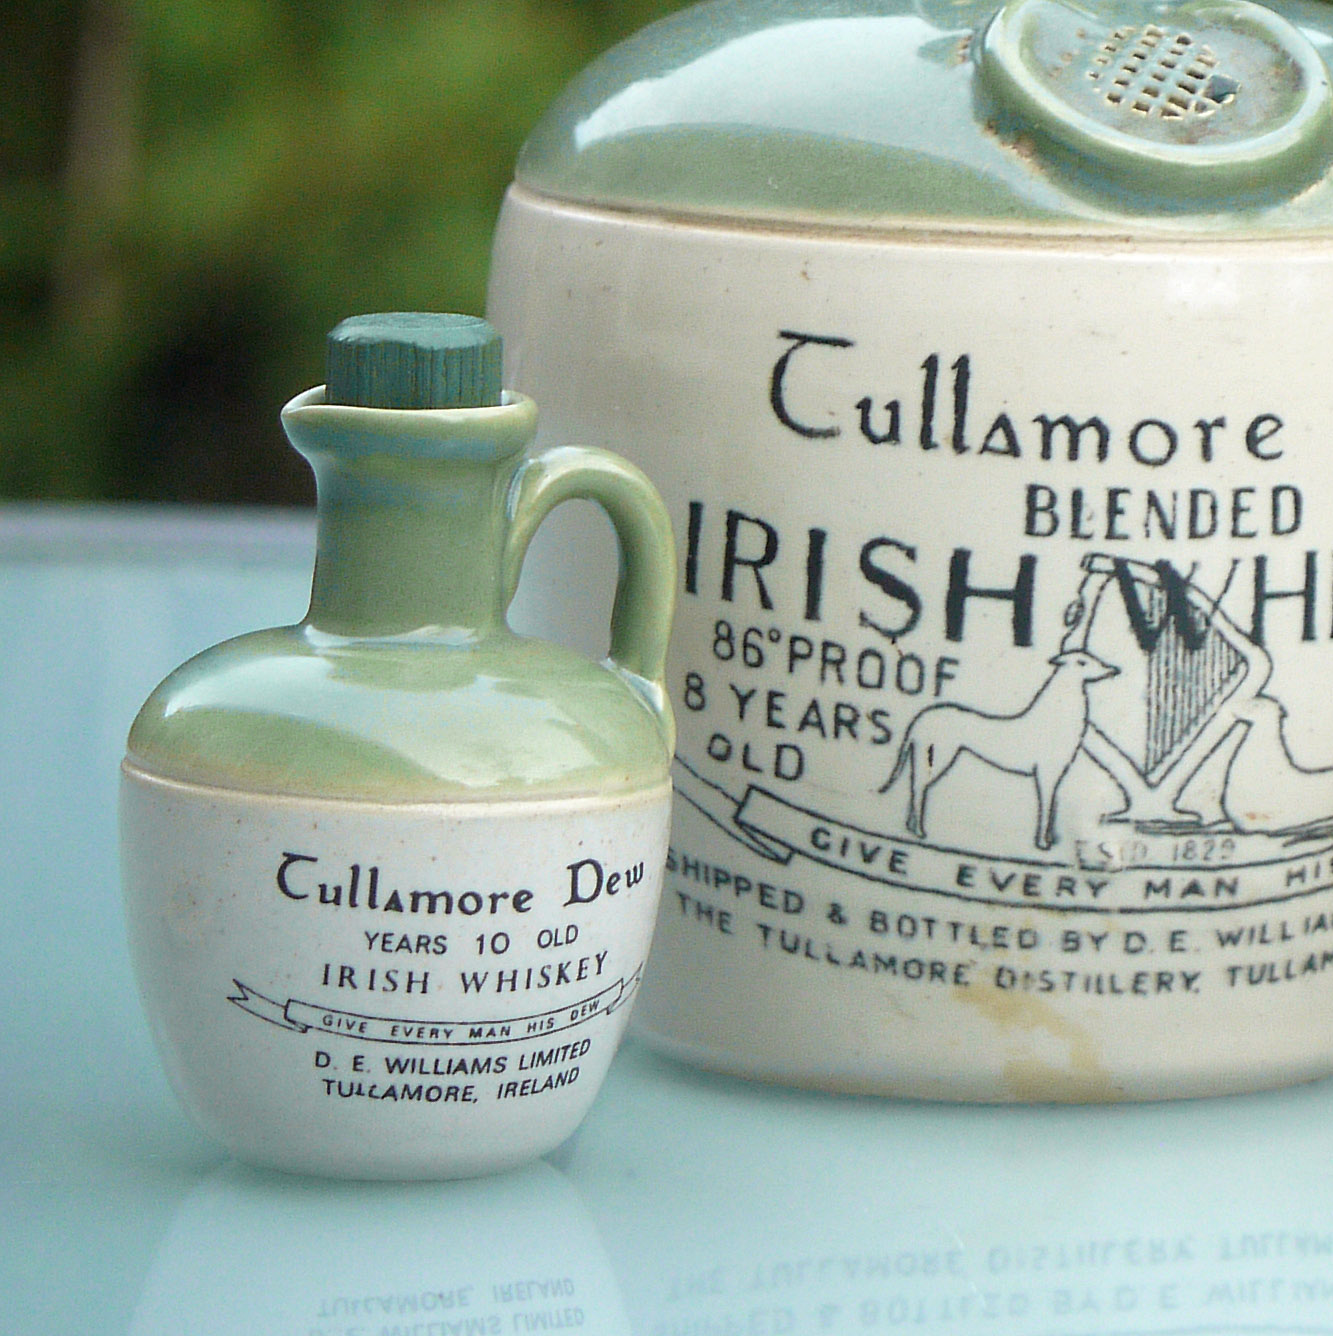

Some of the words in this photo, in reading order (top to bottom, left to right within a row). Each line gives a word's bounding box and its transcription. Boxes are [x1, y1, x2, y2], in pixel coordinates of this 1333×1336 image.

[769, 329, 1286, 465] Tullamore
[1025, 483, 1304, 541] BLENDED
[685, 500, 1038, 647] IRISH
[684, 671, 706, 711] 8
[729, 683, 892, 745] YEARS
[707, 733, 805, 781] OLD
[810, 826, 908, 876] GIVE
[956, 863, 1109, 899] EVERY
[1144, 876, 1239, 899] MAN
[1172, 838, 1236, 862] 1829
[276, 852, 535, 916] Tullamore
[563, 857, 645, 908] Dew
[364, 930, 448, 955] YEARS
[476, 932, 511, 955] 10
[537, 924, 580, 949] OLD
[676, 890, 733, 935] THE
[757, 922, 971, 987] TULLAMORE
[826, 901, 848, 926] &
[870, 909, 1038, 950] BOTTLED
[1062, 929, 1109, 952] BY
[321, 963, 430, 995] IRISH
[460, 950, 609, 994] WHISKEY
[321, 1014, 367, 1034] GIVE
[391, 1024, 453, 1040] EVERY
[468, 1025, 512, 1040] MAN
[527, 1018, 555, 1034] HIS
[570, 999, 601, 1023] DEW
[385, 1055, 508, 1076] WILLIAMS
[517, 1037, 592, 1071] LIMITED
[497, 1066, 580, 1100] IRELAND
